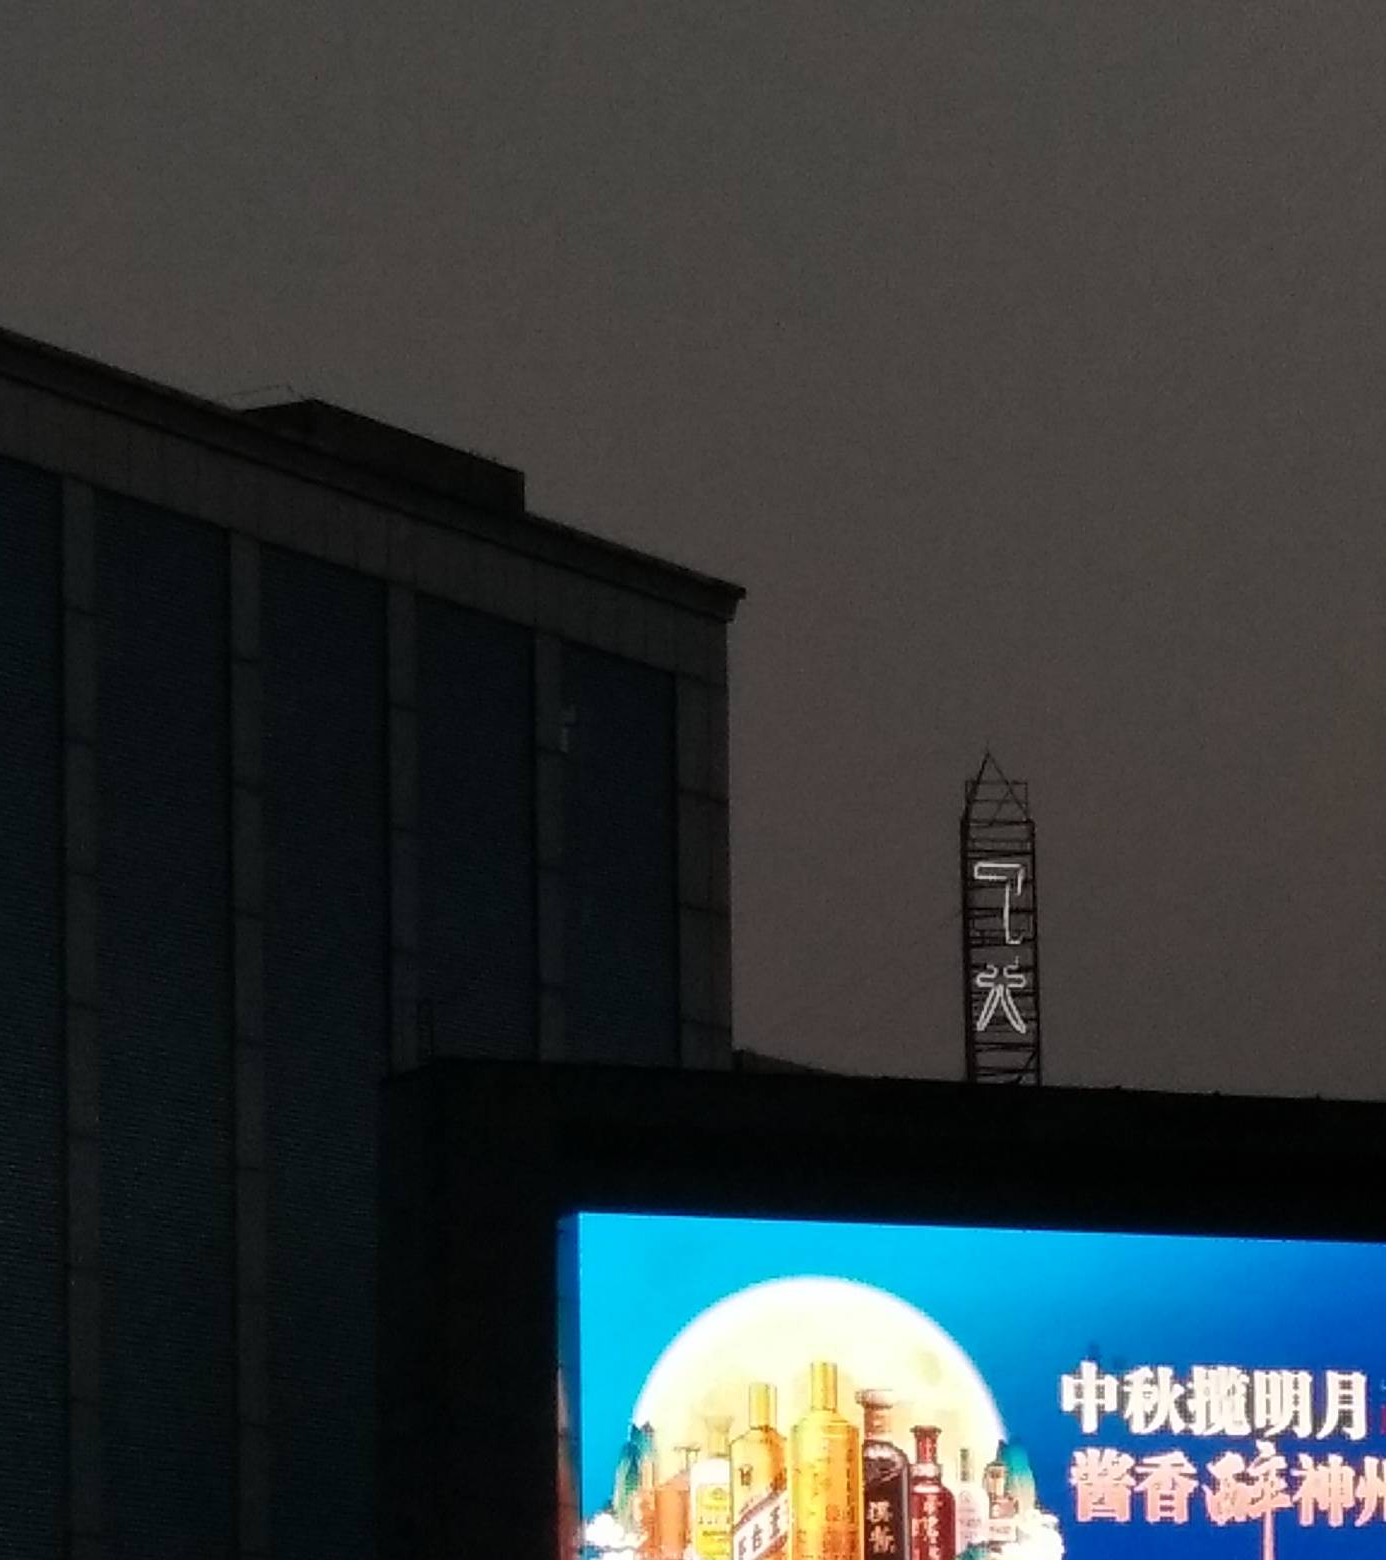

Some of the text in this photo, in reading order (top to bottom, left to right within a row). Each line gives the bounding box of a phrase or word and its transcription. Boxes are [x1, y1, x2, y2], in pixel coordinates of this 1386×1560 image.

[1060, 1360, 1369, 1440] 中秋揽明月
